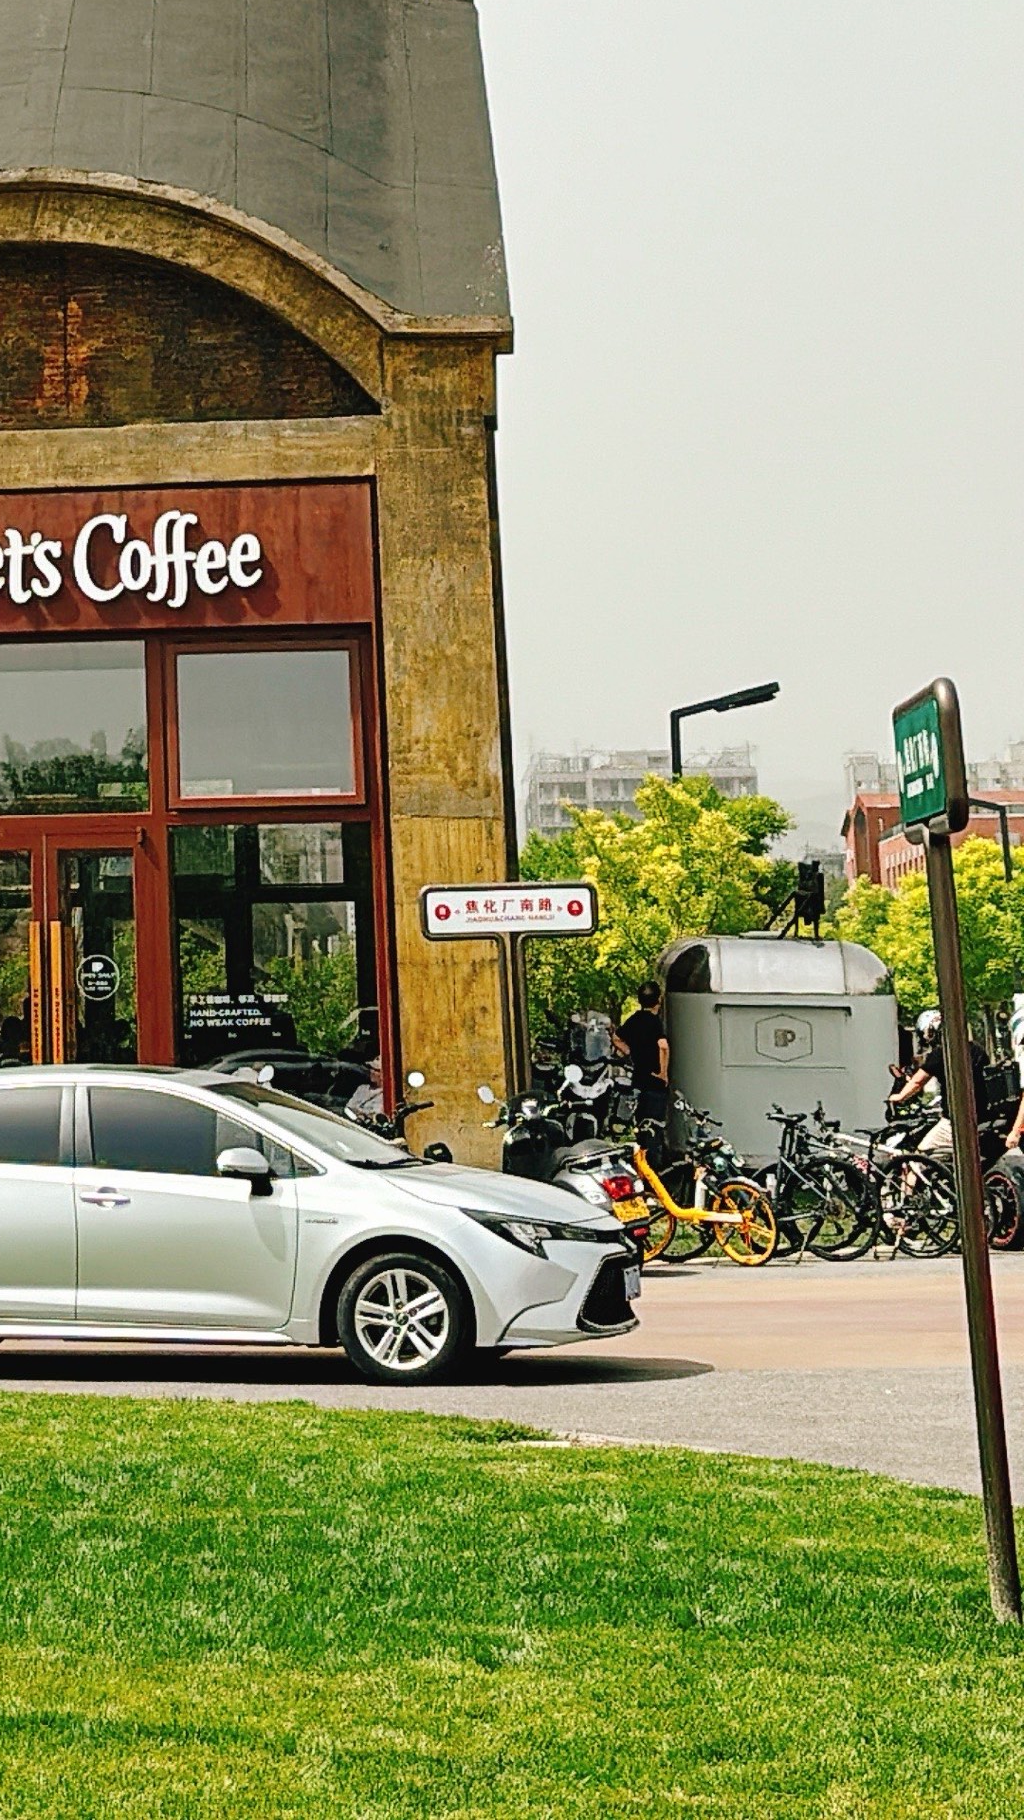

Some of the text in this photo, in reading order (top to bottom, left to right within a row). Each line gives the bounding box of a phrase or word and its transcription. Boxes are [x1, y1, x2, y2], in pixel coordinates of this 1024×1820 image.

[73, 509, 264, 609] Coffee
[465, 897, 553, 915] 焦化厂南路
[235, 1017, 272, 1027] COFFEE
